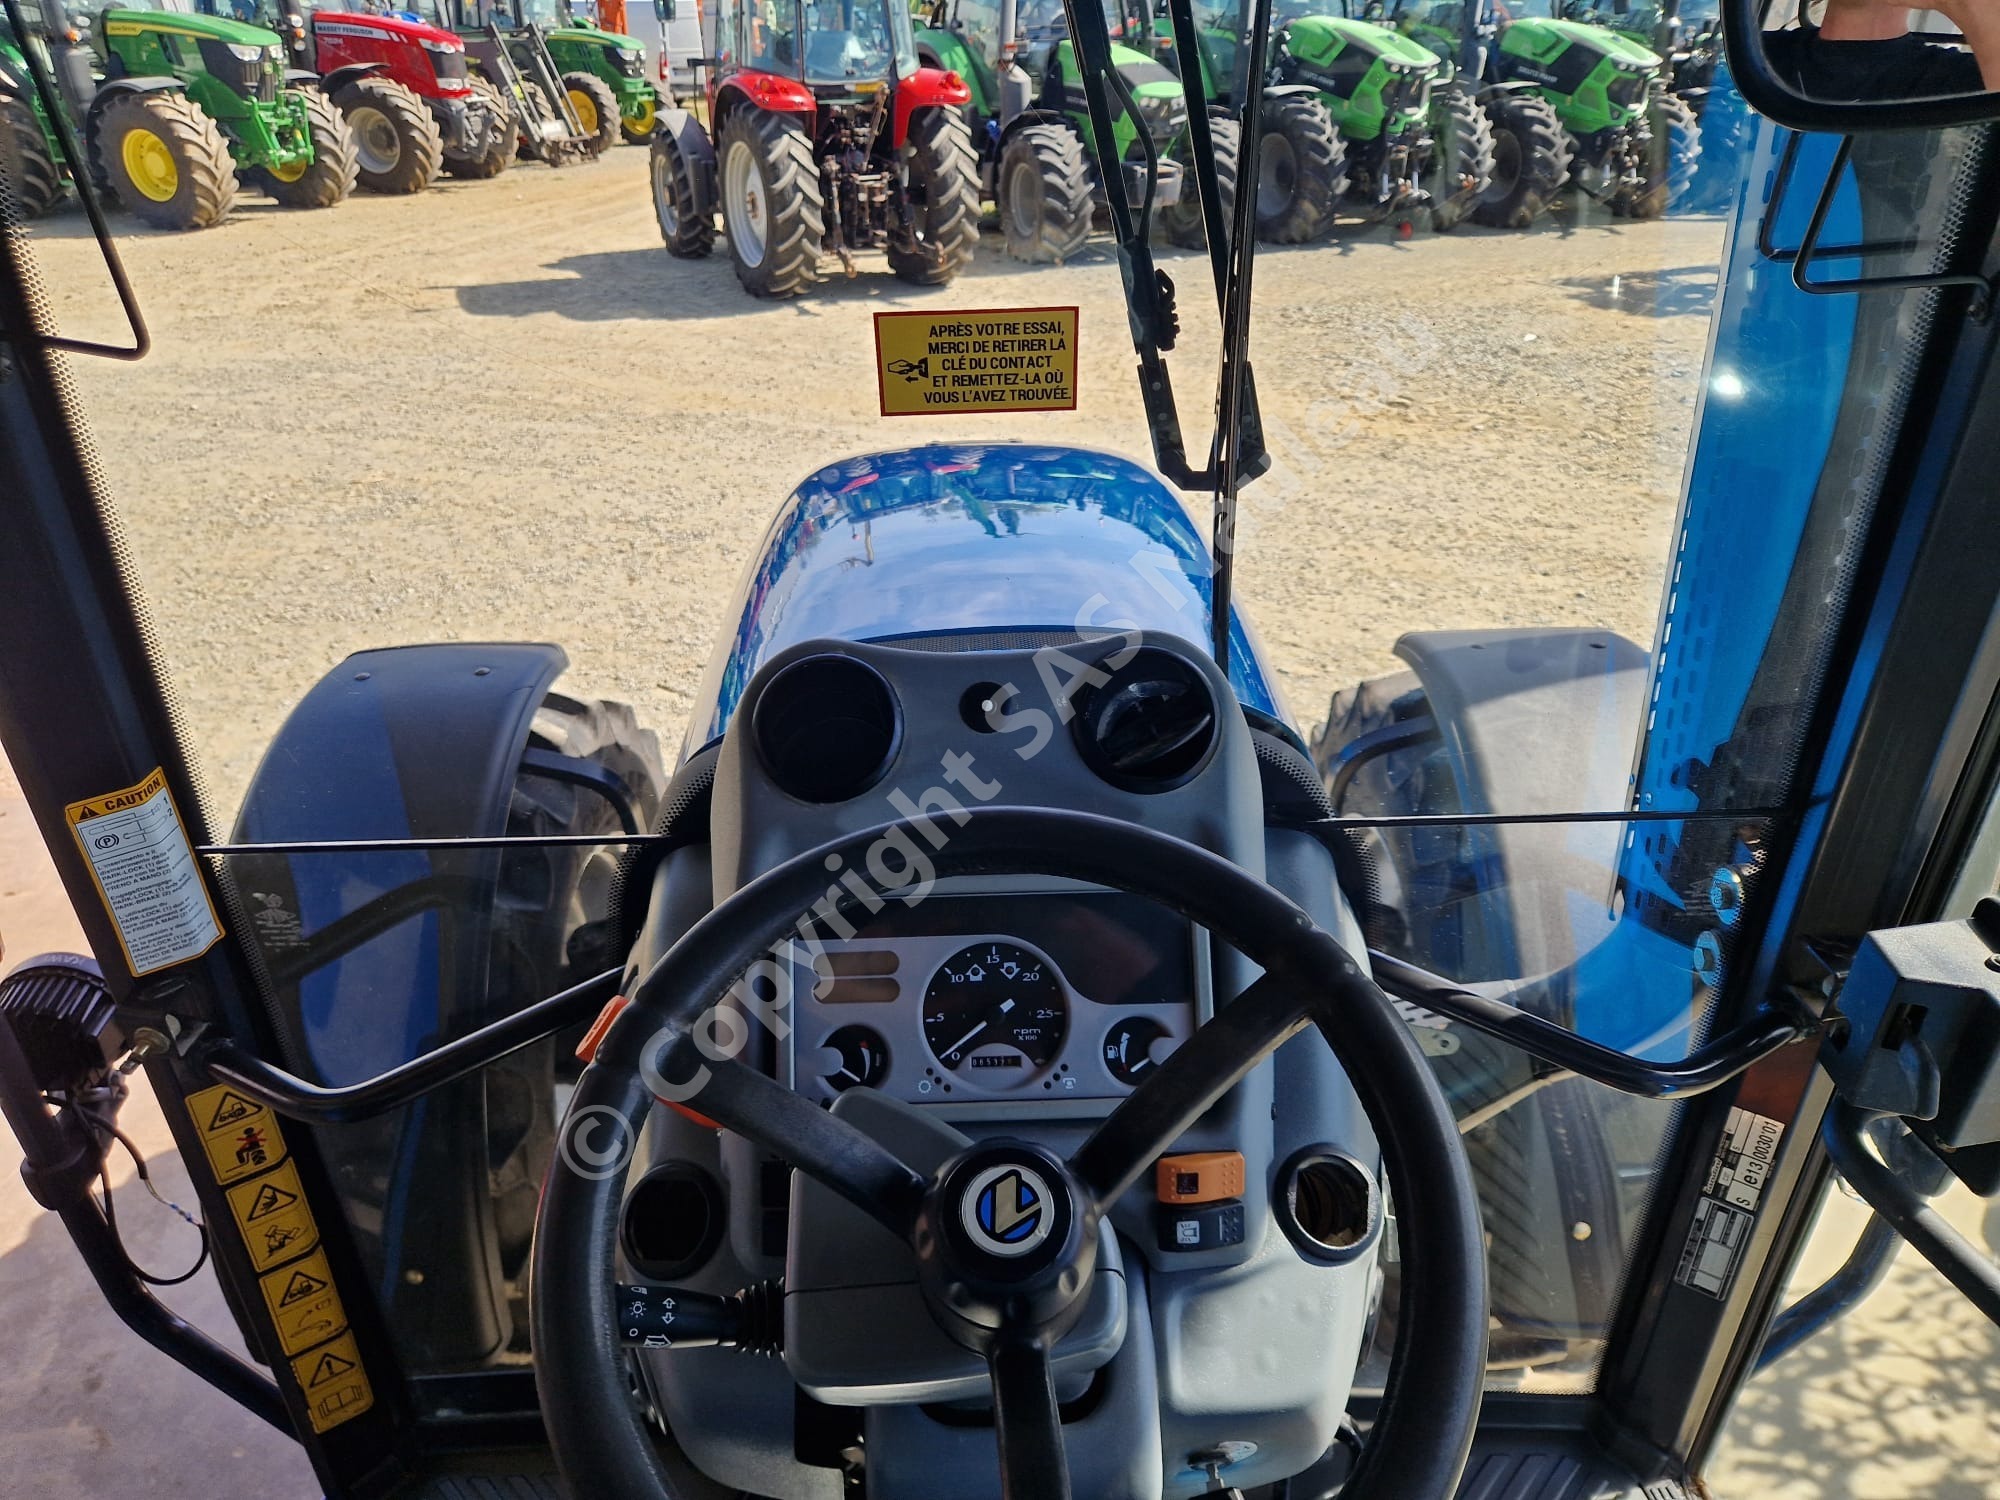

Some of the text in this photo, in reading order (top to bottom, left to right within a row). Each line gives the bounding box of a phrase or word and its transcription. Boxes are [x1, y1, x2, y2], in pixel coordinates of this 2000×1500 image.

[929, 321, 1064, 337] APRÈS VOTRE ESSAI,
[928, 338, 1066, 354] MERCI DE RETIRER LA
[942, 355, 1053, 371] CLÉ DU CONTACT
[933, 369, 1064, 387] ET REMETTEZ-LA OÙ
[924, 386, 1072, 403] VOUS L'AVEZ TROUVÉE.
[104, 777, 161, 810] CAUTION
[163, 796, 168, 804] 1
[167, 808, 173, 816] 2
[986, 955, 1000, 963] 15
[951, 974, 964, 983] 10
[1023, 973, 1040, 981] 20
[937, 1013, 944, 1021] 5
[1037, 1010, 1054, 1018] 25
[951, 1052, 960, 1060] 0
[1742, 1160, 1764, 1186] e13
[1735, 1196, 1751, 1207] S
